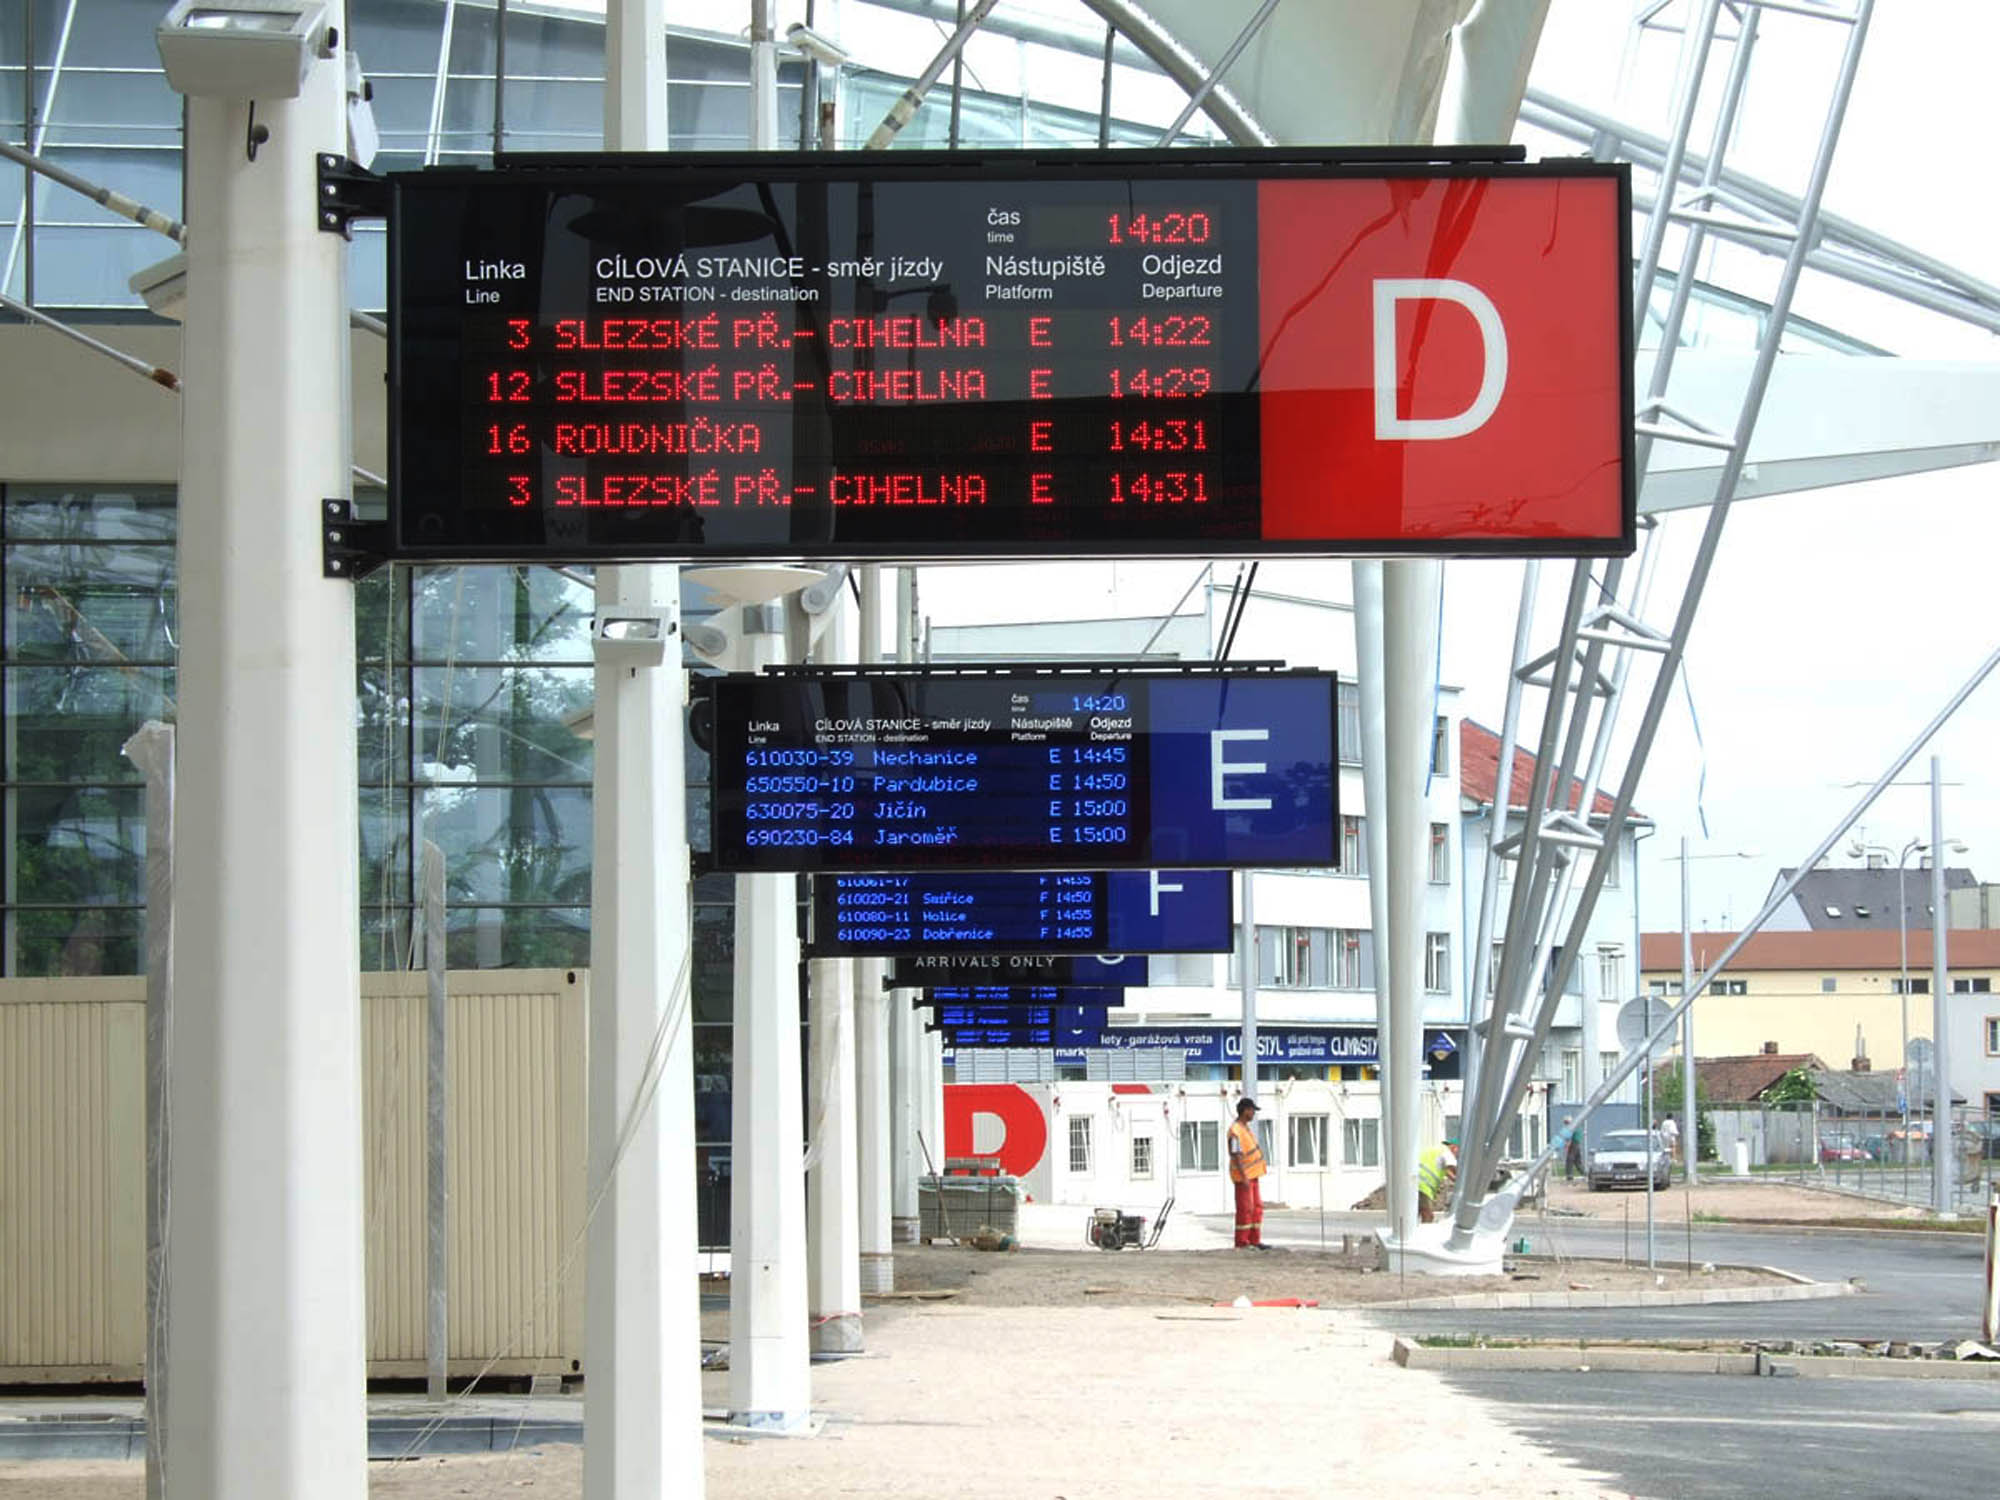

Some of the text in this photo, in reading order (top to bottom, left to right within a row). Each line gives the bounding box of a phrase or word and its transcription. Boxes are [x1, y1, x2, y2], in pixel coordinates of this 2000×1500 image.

[987, 207, 1021, 226] čas
[987, 231, 1015, 243] time
[1108, 213, 1210, 244] 14:20
[466, 259, 526, 280] Linka
[596, 253, 690, 279] CÍLOVÁ
[696, 257, 804, 278] STANICE
[827, 256, 885, 278] směr
[889, 256, 944, 282] jízdy
[986, 255, 1106, 281] Nástupiště
[1142, 253, 1222, 280] Odjezd
[465, 289, 500, 304] Line
[596, 286, 635, 303] END
[639, 285, 715, 302] STATION
[730, 285, 819, 302] destination
[985, 284, 1053, 300] Platform
[1142, 283, 1223, 301] Departure
[508, 319, 530, 350] 3
[555, 311, 721, 350] SLEZSKÉ
[828, 317, 986, 348] CIHELNA
[1029, 317, 1053, 347] E
[1109, 315, 1211, 347] 14:22
[1373, 279, 1508, 440] D
[488, 370, 531, 401] 12
[555, 363, 721, 401] SLEZSKÉ
[828, 369, 986, 401] CIHELNA
[1030, 368, 1053, 399] E
[1109, 367, 1211, 398] 14:29
[488, 415, 1207, 454] 16 ROUDNIČKA E 14:31
[508, 476, 531, 506] 3
[555, 468, 721, 507] SLEZSKÉ
[829, 474, 987, 505] CIHELNA
[1031, 473, 1054, 504] E
[1110, 472, 1208, 503] 14:31
[1073, 695, 1126, 712] 14:20
[748, 720, 780, 732] Linka
[815, 716, 864, 732] CÍLOVÁ
[865, 718, 921, 731] STANICE
[931, 717, 962, 730] směr
[963, 717, 992, 732] jízdy
[1011, 716, 1073, 731] Nástupiště
[1090, 716, 1132, 731] Odjezd
[837, 733, 876, 743] STATION
[882, 733, 929, 743] destination
[1011, 732, 1047, 741] Platform
[1090, 731, 1133, 742] Departure
[746, 747, 1126, 766] 610030-39 Nechanice E 14:45
[1211, 729, 1272, 810] E
[745, 773, 1126, 793] 650550-10 Pardubice E 14:50
[746, 799, 1127, 820] 630075-20 Jičín E 15:00
[746, 826, 1126, 846] 690230-84 Jaroměř E 15:00
[837, 892, 909, 905] 610020-21
[1039, 891, 1049, 903] F
[1056, 890, 1092, 903] 14:50
[922, 911, 967, 922] Holice
[1039, 909, 1049, 921] F
[1056, 908, 1093, 921] 14:55
[1039, 927, 1049, 938] F
[1056, 926, 1093, 939] 14:55
[914, 956, 1056, 969] ARRIVALS ONLY
[1184, 1034, 1214, 1045] vrata
[1226, 1035, 1284, 1056] CLISTYL
[1331, 1036, 1378, 1057] CLIMASTY
